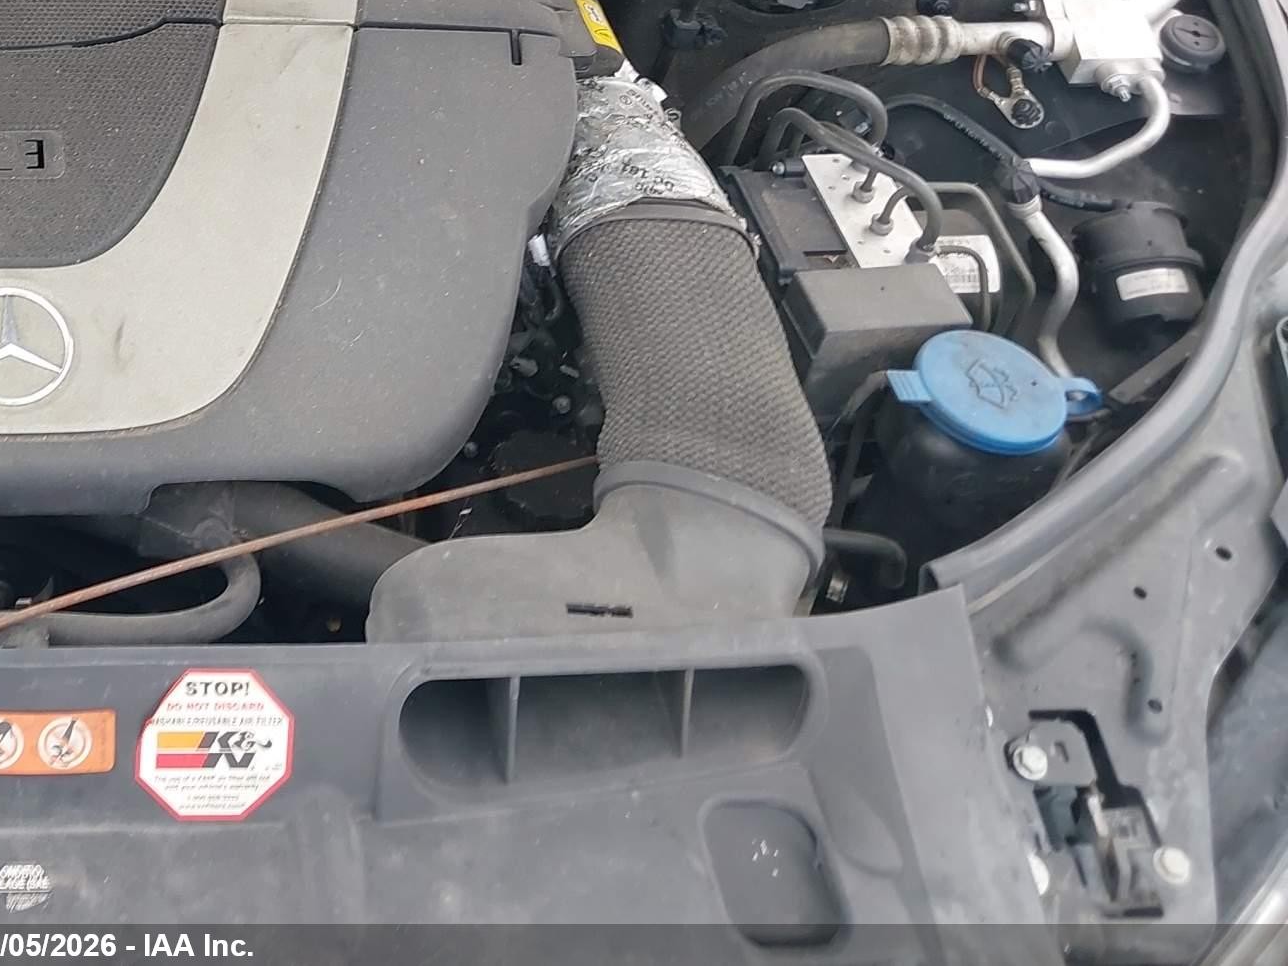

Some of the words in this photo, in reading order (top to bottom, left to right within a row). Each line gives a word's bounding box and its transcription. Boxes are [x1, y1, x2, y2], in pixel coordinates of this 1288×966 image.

[185, 681, 250, 696] STOP!
[186, 702, 210, 712] NOT
[213, 702, 265, 712] DISCARD
